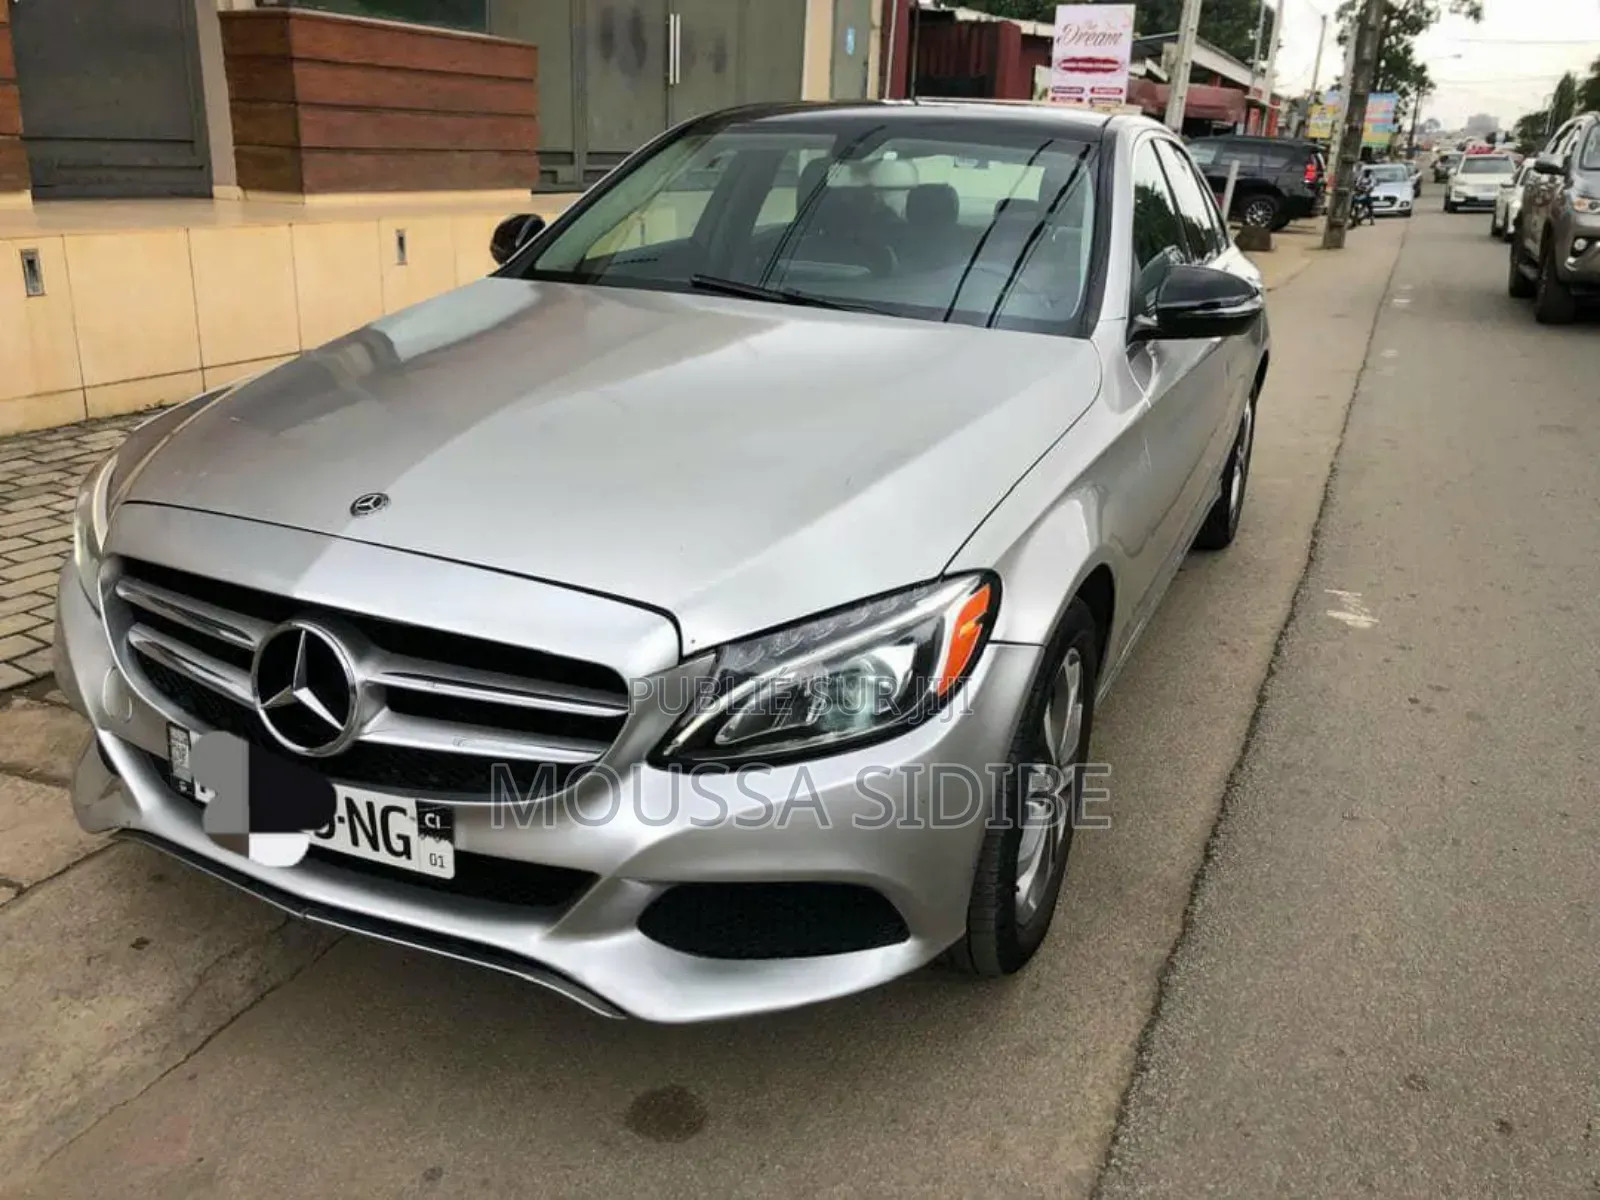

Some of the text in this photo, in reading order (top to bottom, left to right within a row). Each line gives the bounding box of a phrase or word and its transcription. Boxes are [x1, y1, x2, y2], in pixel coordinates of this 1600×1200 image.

[1057, 23, 1123, 48] Dream
[424, 813, 441, 829] CI
[429, 853, 446, 868] 01
